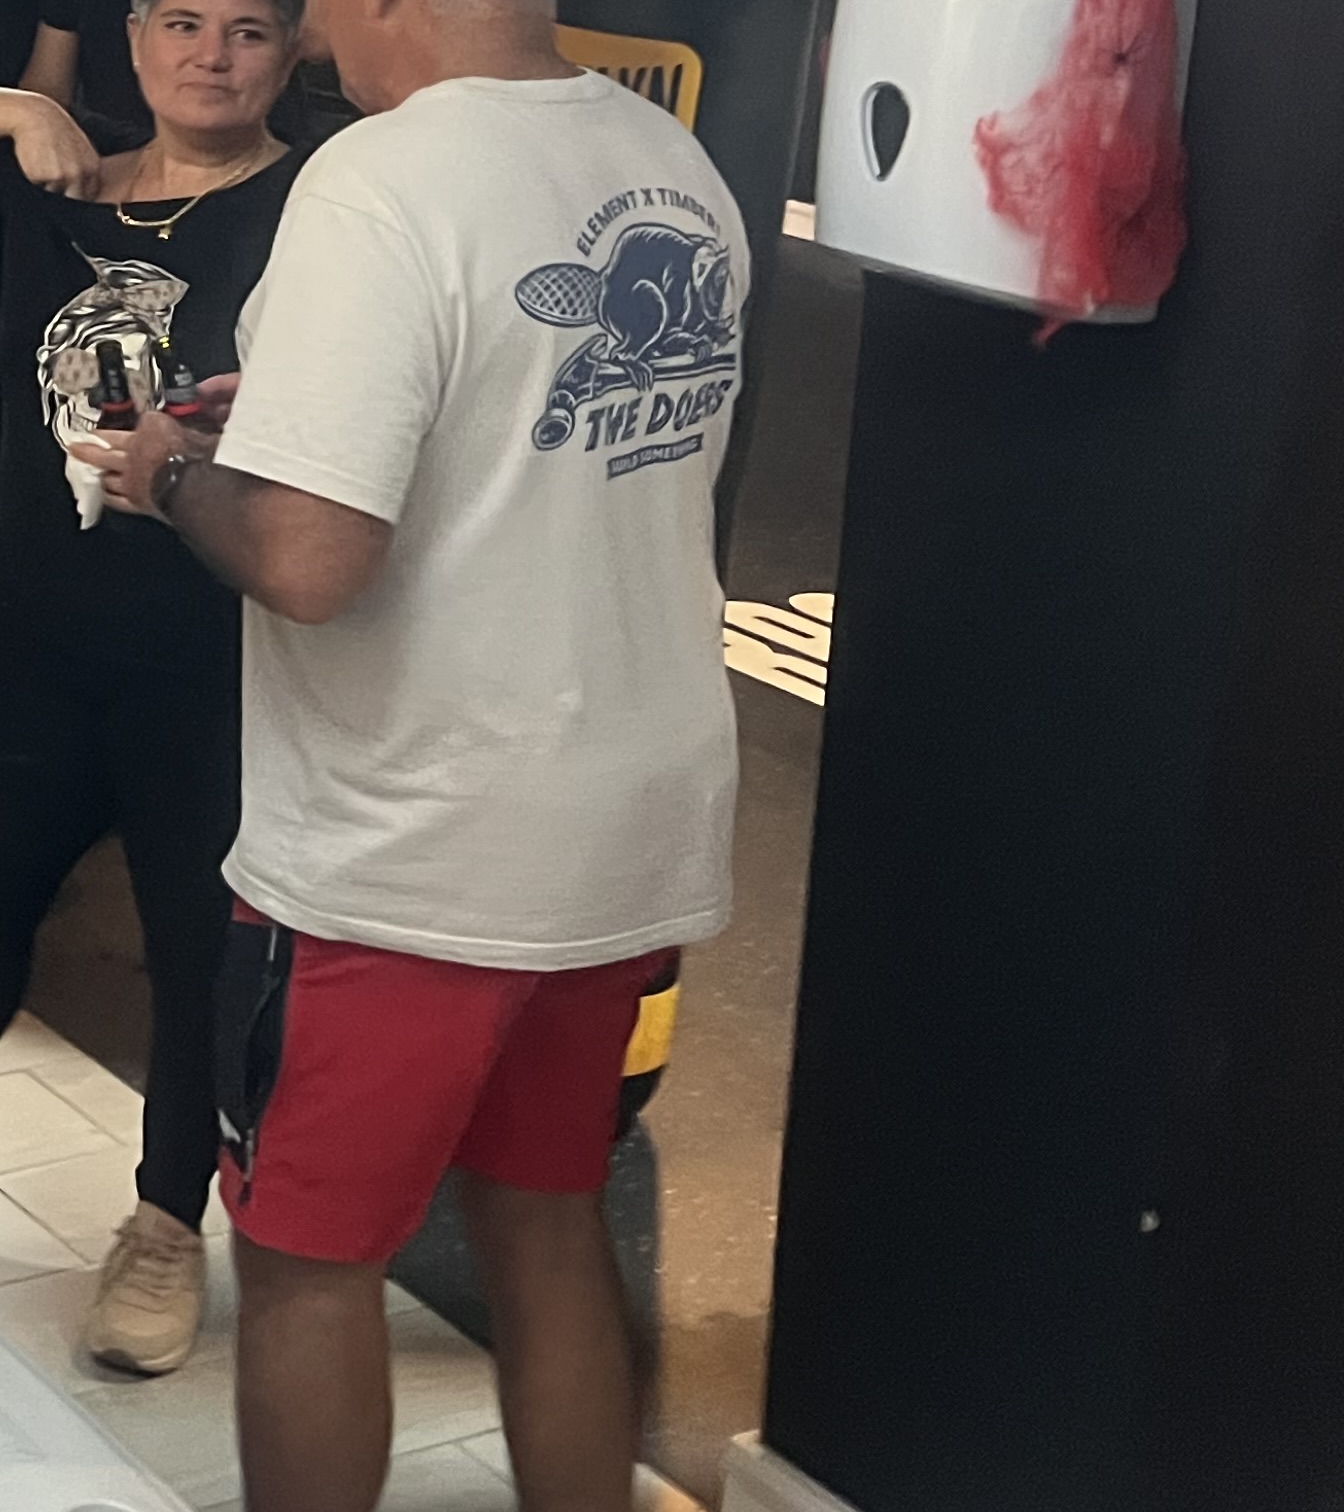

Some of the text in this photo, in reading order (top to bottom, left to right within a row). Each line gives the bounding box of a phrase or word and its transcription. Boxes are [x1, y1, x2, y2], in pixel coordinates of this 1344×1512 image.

[577, 189, 637, 257] ELEMENT
[640, 188, 655, 206] X
[584, 395, 644, 453] THE
